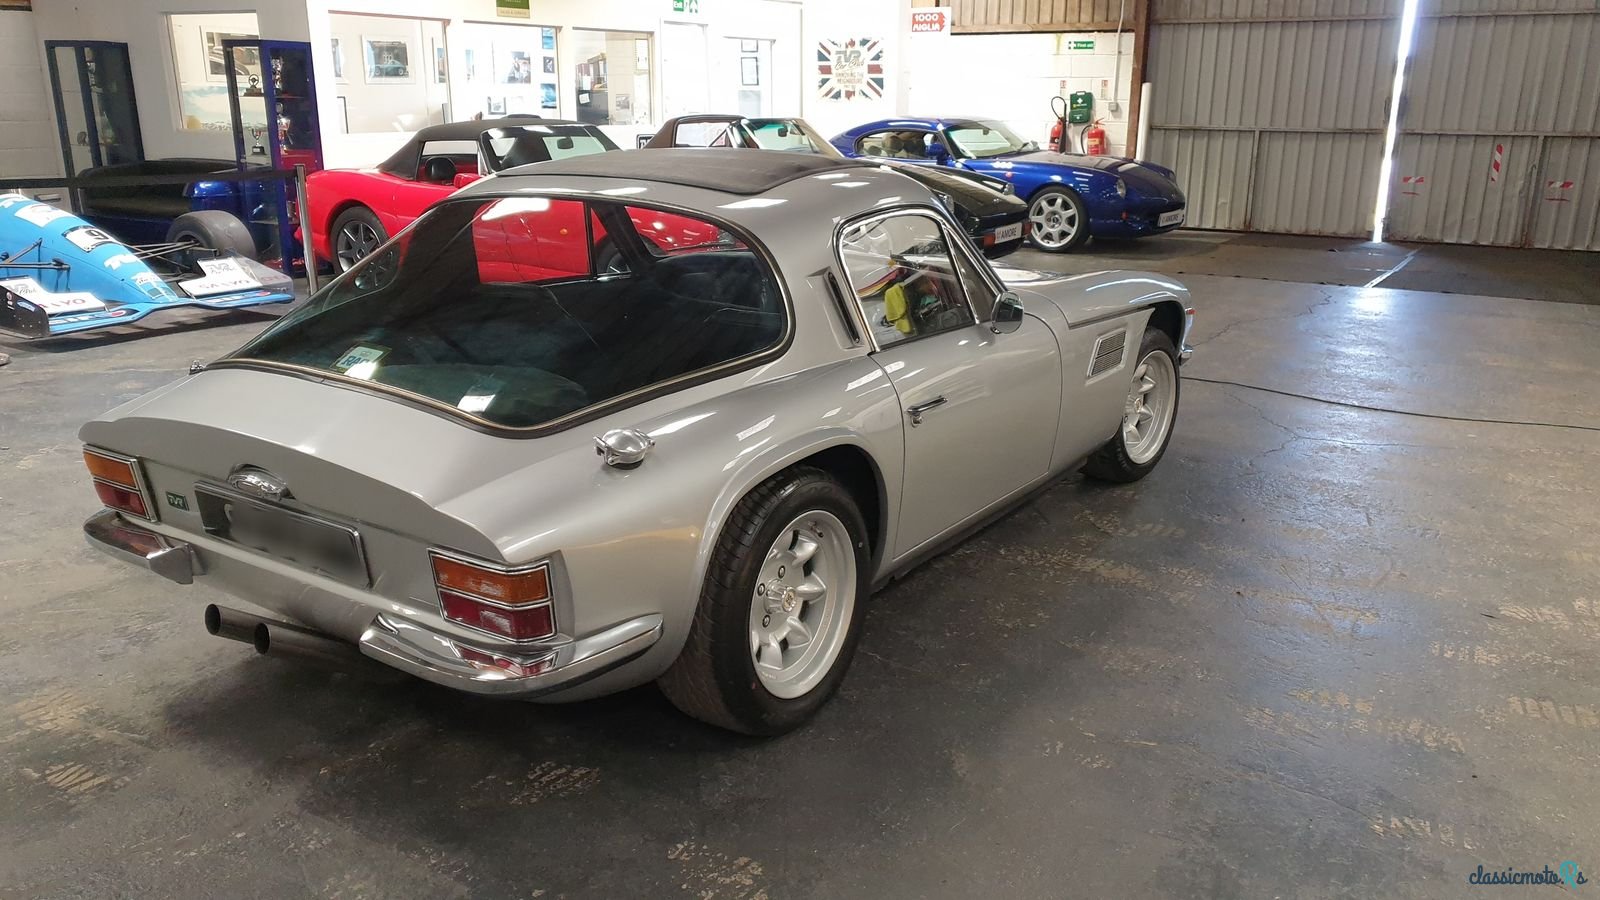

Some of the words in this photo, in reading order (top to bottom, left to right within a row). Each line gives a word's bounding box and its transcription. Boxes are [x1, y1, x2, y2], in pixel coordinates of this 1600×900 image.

[914, 13, 939, 22] 1000
[912, 23, 941, 32] MIGLIA
[835, 50, 861, 63] TVR
[1001, 227, 1016, 239] AMORE
